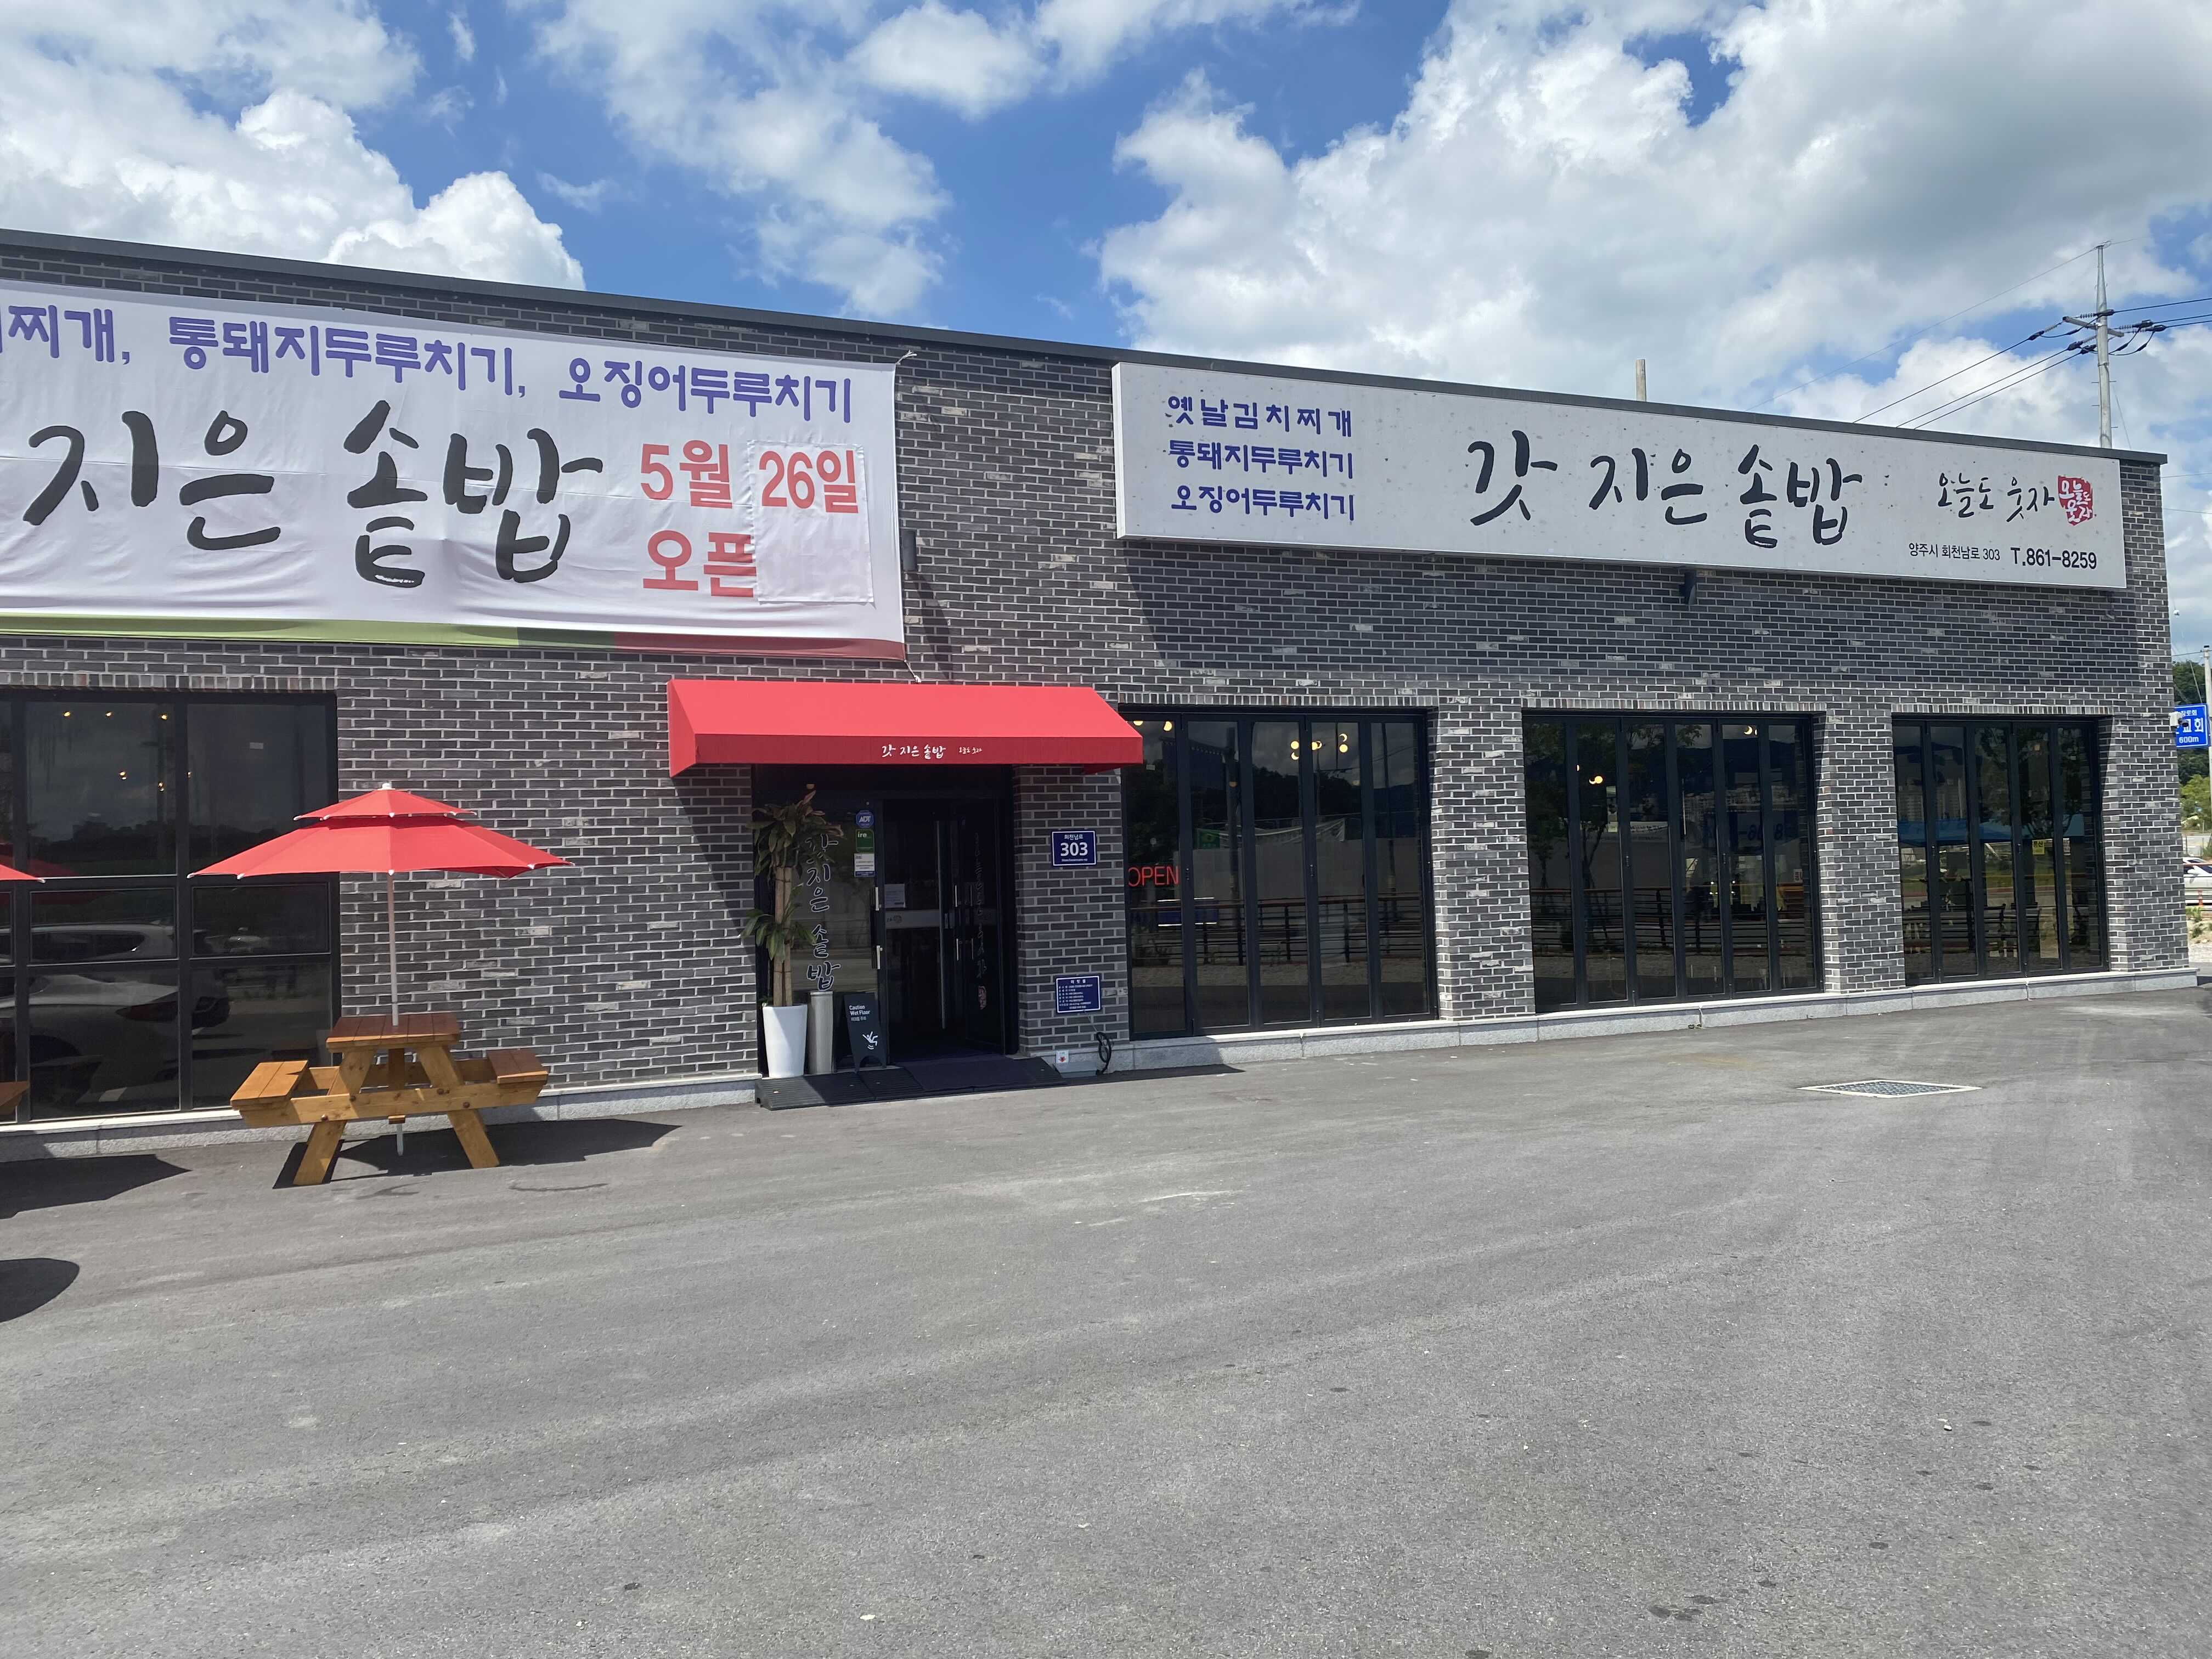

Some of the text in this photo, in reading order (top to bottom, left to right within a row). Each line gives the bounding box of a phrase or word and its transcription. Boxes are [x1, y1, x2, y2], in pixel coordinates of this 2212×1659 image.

[0, 304, 851, 422] 찌개, 통돼지두루치기, 오징어두루치기
[1167, 396, 1352, 437] 옛날김치찌개
[641, 439, 859, 514] 5월 26일
[1169, 439, 1353, 479] 통돼지두루치기
[23, 400, 603, 589] 지은 솥밥
[1171, 484, 1355, 521] 오징어두루치기
[1468, 430, 1863, 549] 갓 지은 솥밥
[1938, 472, 2055, 523] 오늘도 웃자
[642, 530, 757, 597] 오픈
[1909, 543, 2000, 561] 양주시 회천남로 303
[2010, 547, 2097, 569] T.861-8259
[882, 744, 947, 760] 갓 지은 솥밥
[1060, 842, 1088, 857] 303
[806, 864, 831, 913] 지은
[1128, 865, 1180, 887] OPEN
[806, 923, 841, 992] 솥밥
